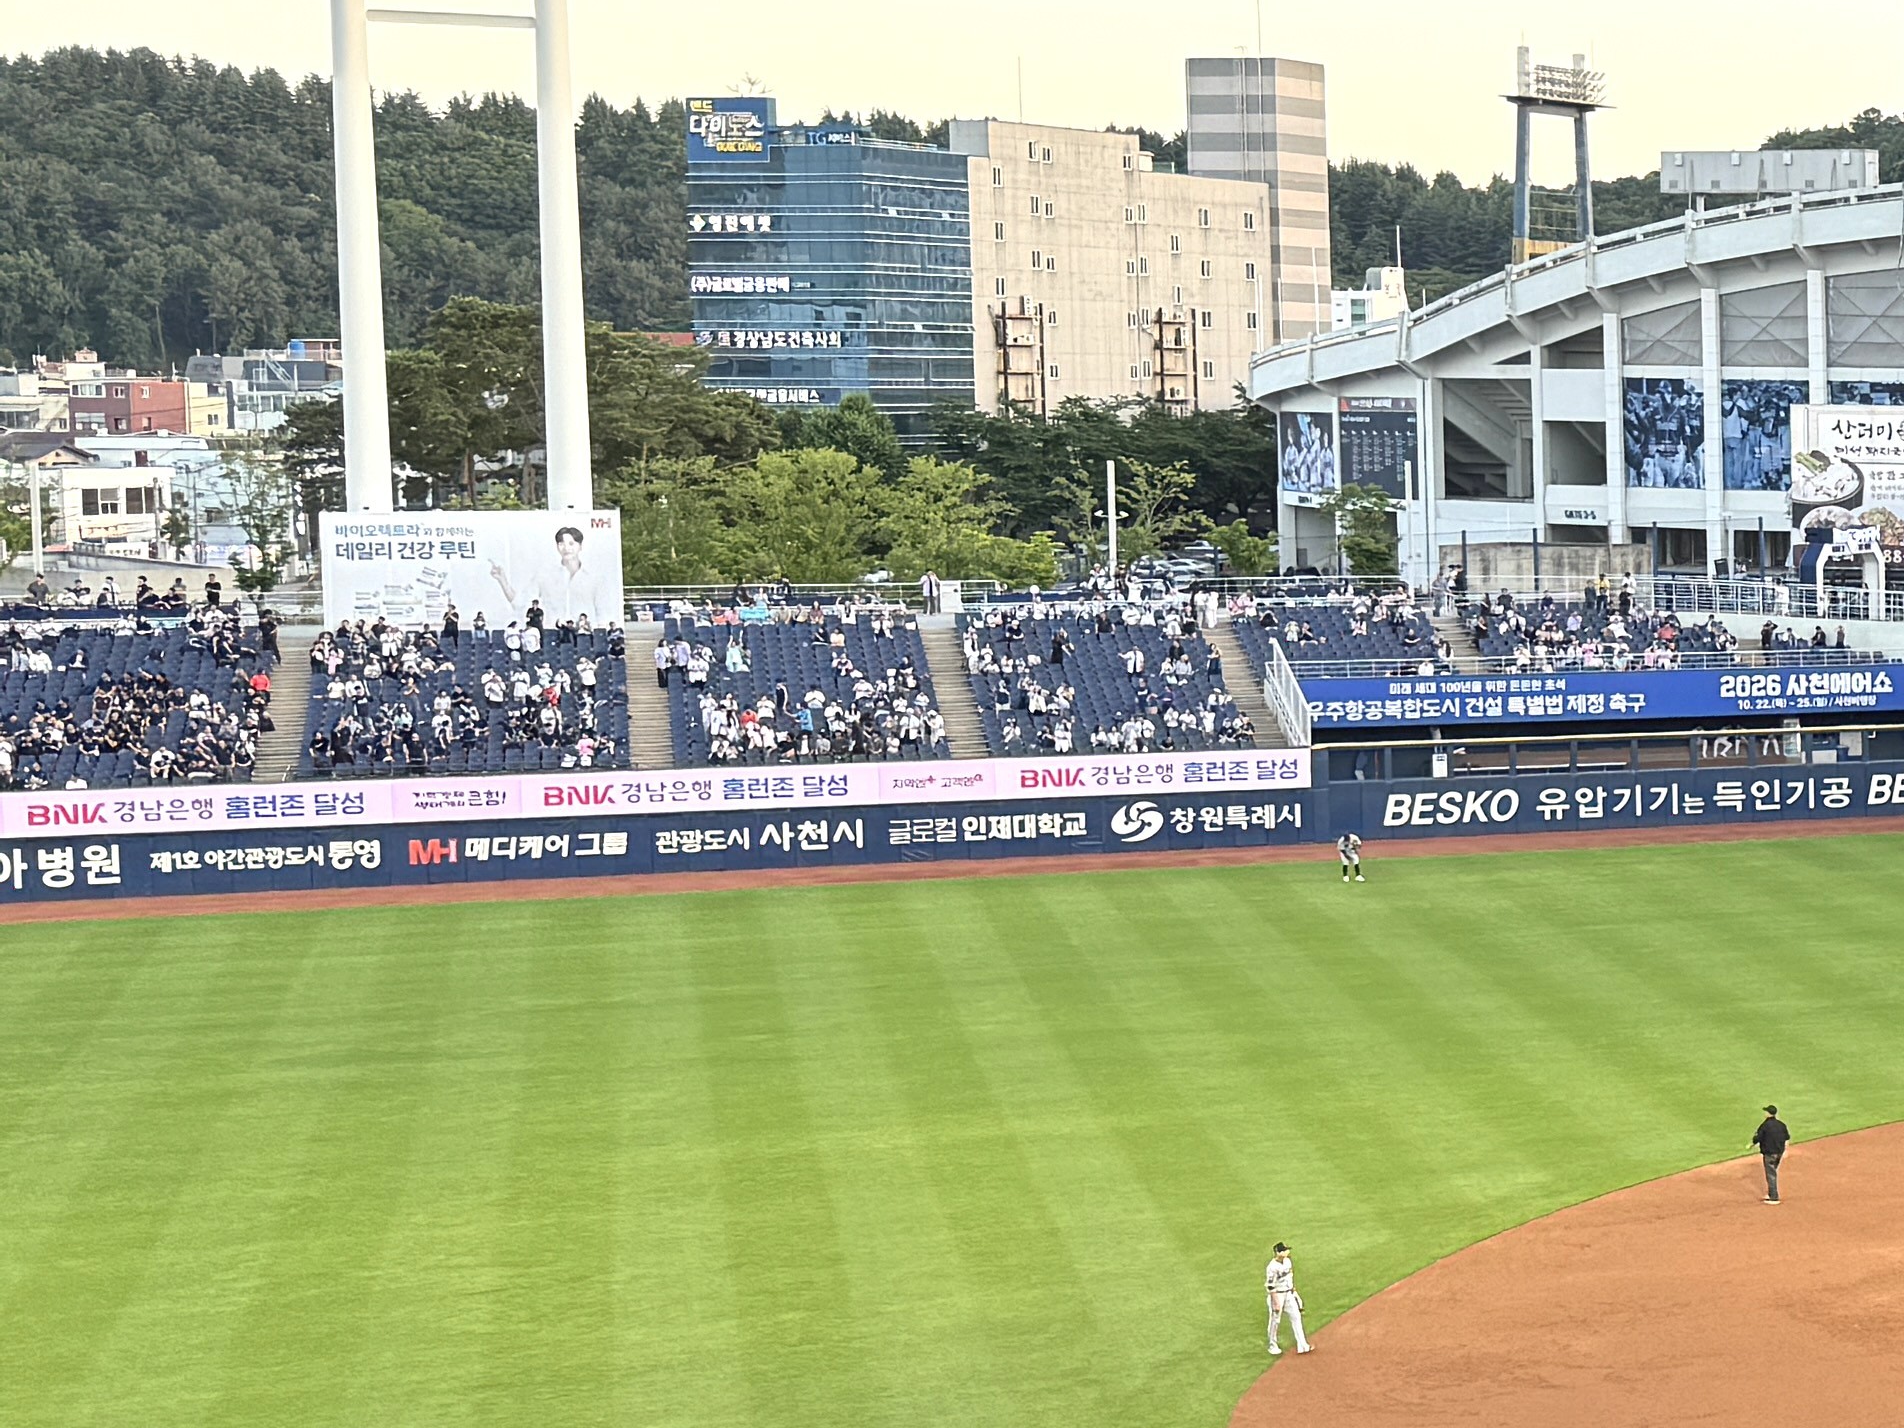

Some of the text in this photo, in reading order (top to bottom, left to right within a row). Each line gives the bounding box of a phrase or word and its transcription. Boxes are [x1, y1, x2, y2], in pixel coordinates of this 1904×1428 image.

[1832, 420, 1892, 440] 산더미
[335, 540, 476, 561] 데일리 건강 루틴
[1485, 680, 1507, 693] 위한
[1719, 671, 1894, 698] 2026 사천에어쇼
[1308, 698, 1460, 722] 우주항공복합도시
[1465, 695, 1503, 717] 건설
[1507, 694, 1564, 715] 특별법
[1567, 693, 1605, 715] 제정
[543, 773, 849, 807] BNK 경남은행 홈런존 달성
[1020, 758, 1299, 789] BNK 경남은행 홈런존 달성
[27, 791, 365, 826] BNK 경남은행 홈런존 달성
[1170, 803, 1302, 833] 창원특례시
[1383, 787, 1520, 827] BESKO
[1535, 783, 1705, 821] 유압기기는
[1712, 777, 1854, 812] 득인기공
[655, 818, 865, 854] 관광도시 사천시
[888, 811, 1088, 845] 글로컬 인제대학교
[149, 839, 381, 873] 제1호 야간관광도시 통영
[408, 832, 629, 865] MH 메디케어 그룹
[37, 844, 122, 889] 병원
